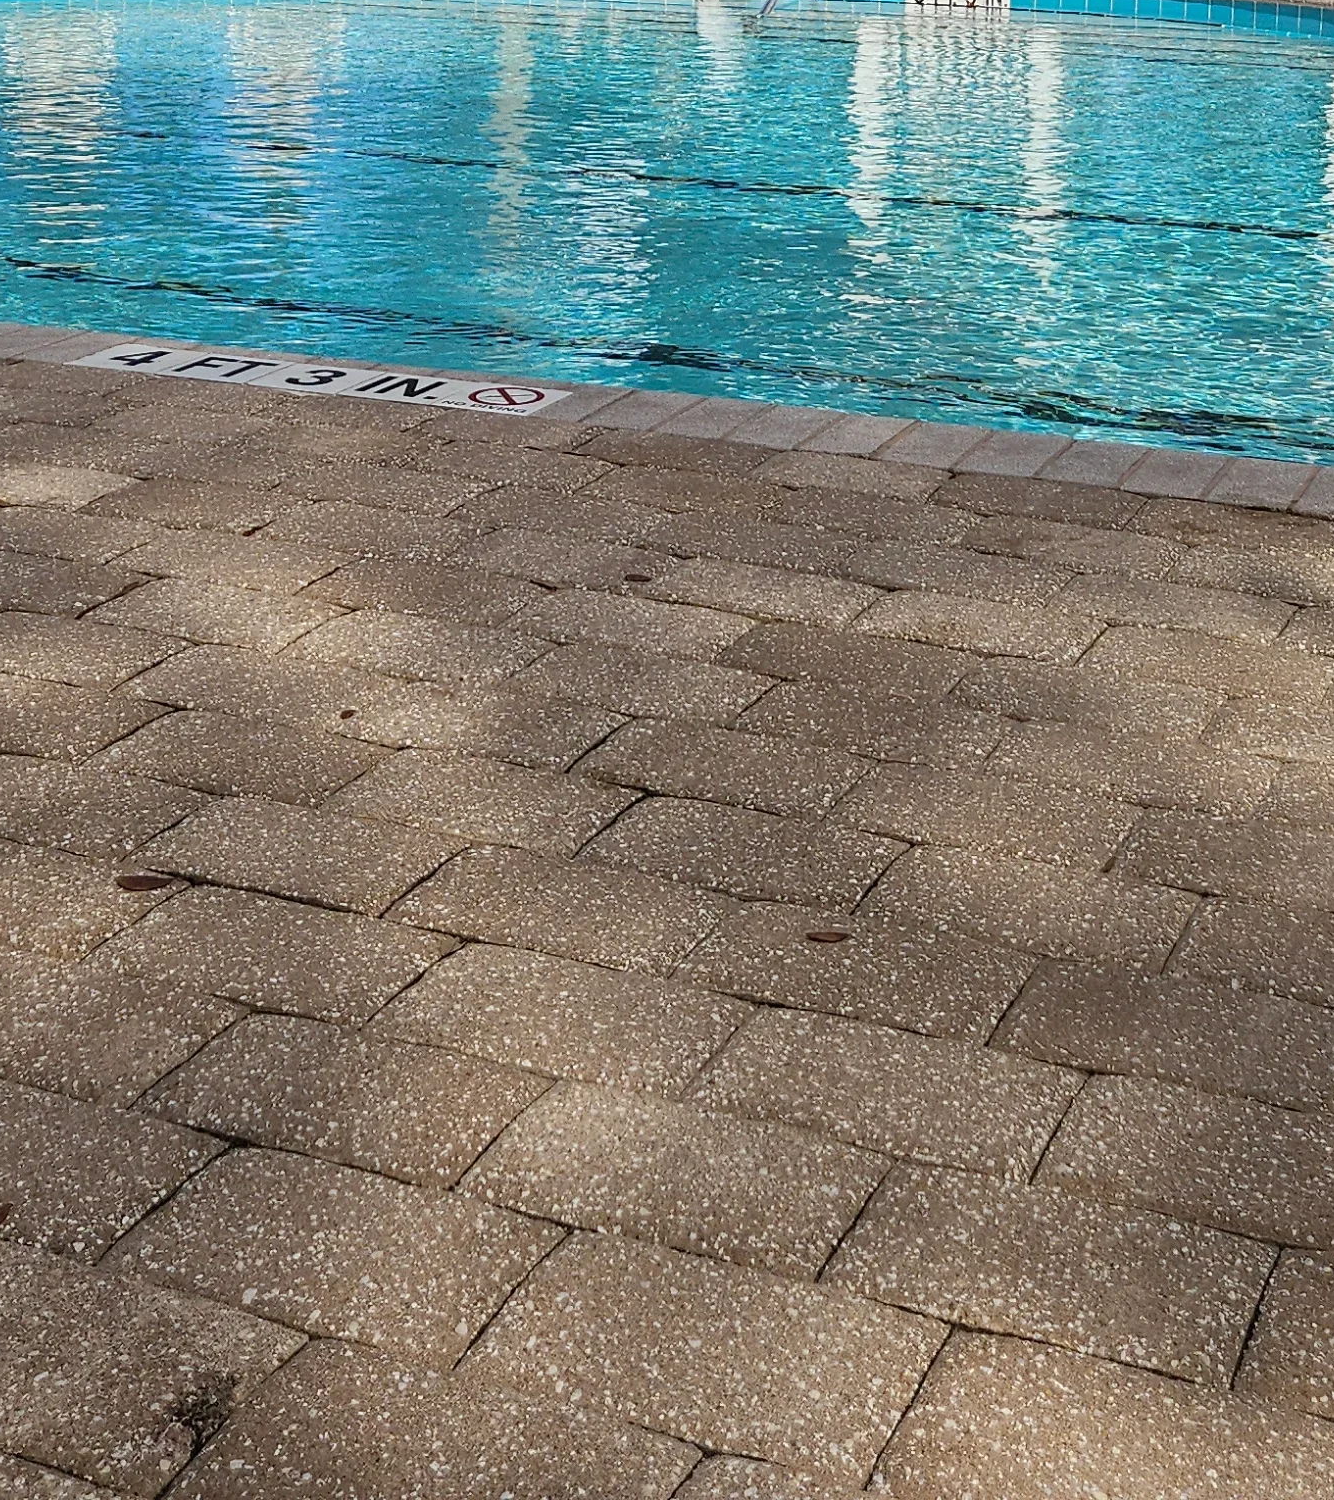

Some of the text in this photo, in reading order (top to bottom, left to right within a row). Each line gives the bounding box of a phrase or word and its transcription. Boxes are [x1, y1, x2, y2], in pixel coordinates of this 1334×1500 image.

[109, 350, 448, 399] 4 FT 3 IN.
[470, 403, 527, 414] DIVING
